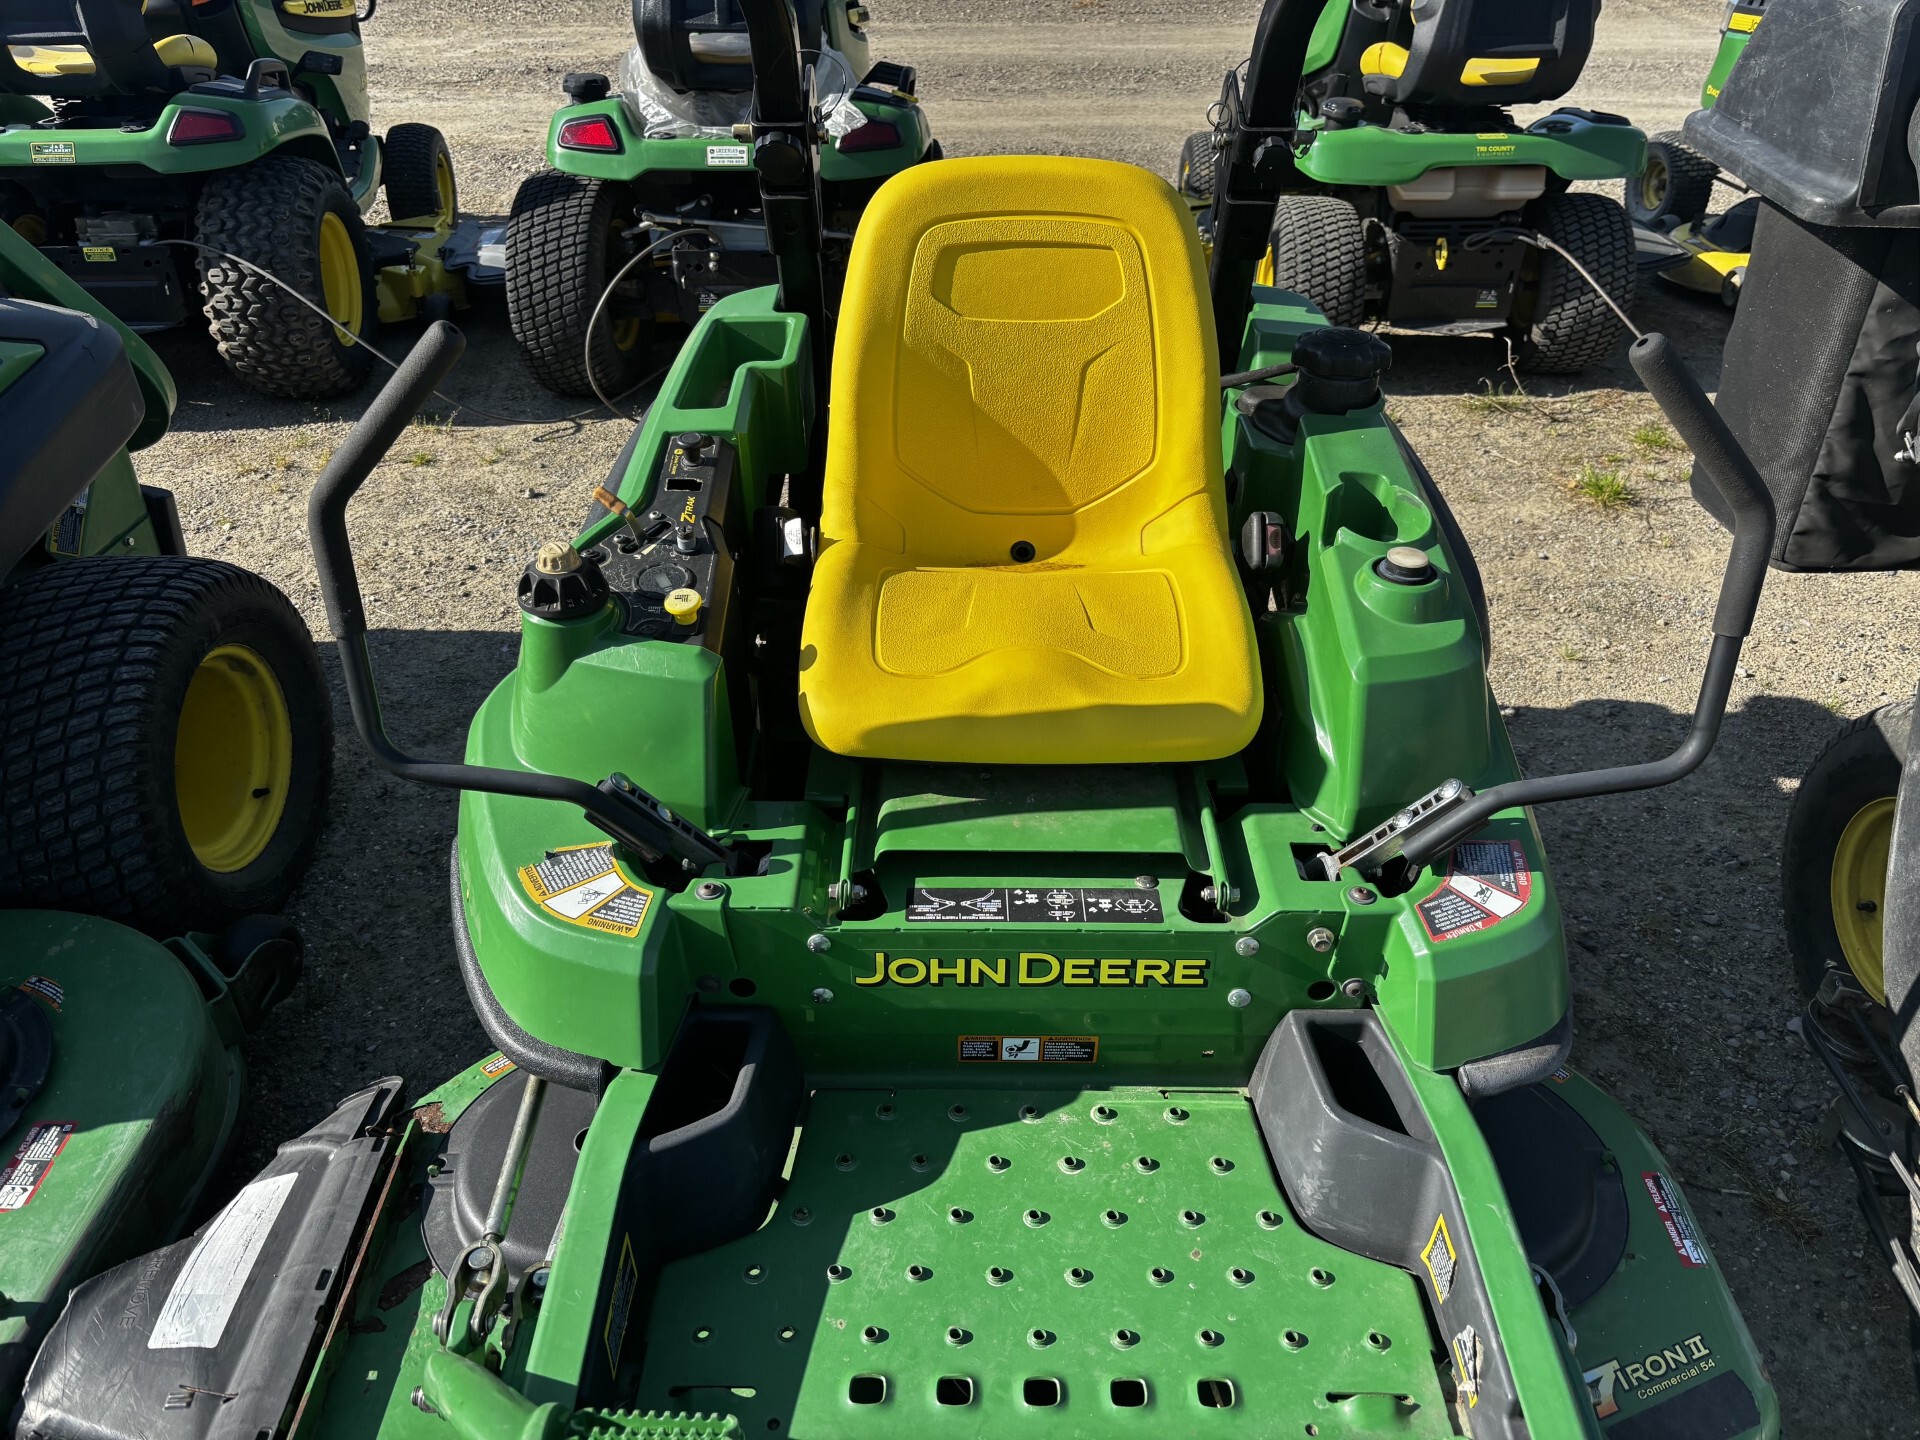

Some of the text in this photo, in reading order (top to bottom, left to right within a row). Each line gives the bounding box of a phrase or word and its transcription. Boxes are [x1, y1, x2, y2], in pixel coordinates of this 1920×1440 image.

[304, 0, 344, 14] JOHN DEERE
[1515, 858, 1528, 886] PELIGRO
[587, 918, 626, 933] WARNING
[1444, 924, 1478, 940] DANGER
[855, 952, 1210, 987] JOHN DEERE
[20, 1126, 40, 1153] PELIGRO
[1644, 1178, 1662, 1204] PELIGRO
[1664, 1220, 1683, 1247] DANGER
[119, 1254, 166, 1329] REMOVE
[1614, 1343, 1690, 1392] IRON
[1637, 1358, 1716, 1400] Commercial 54
